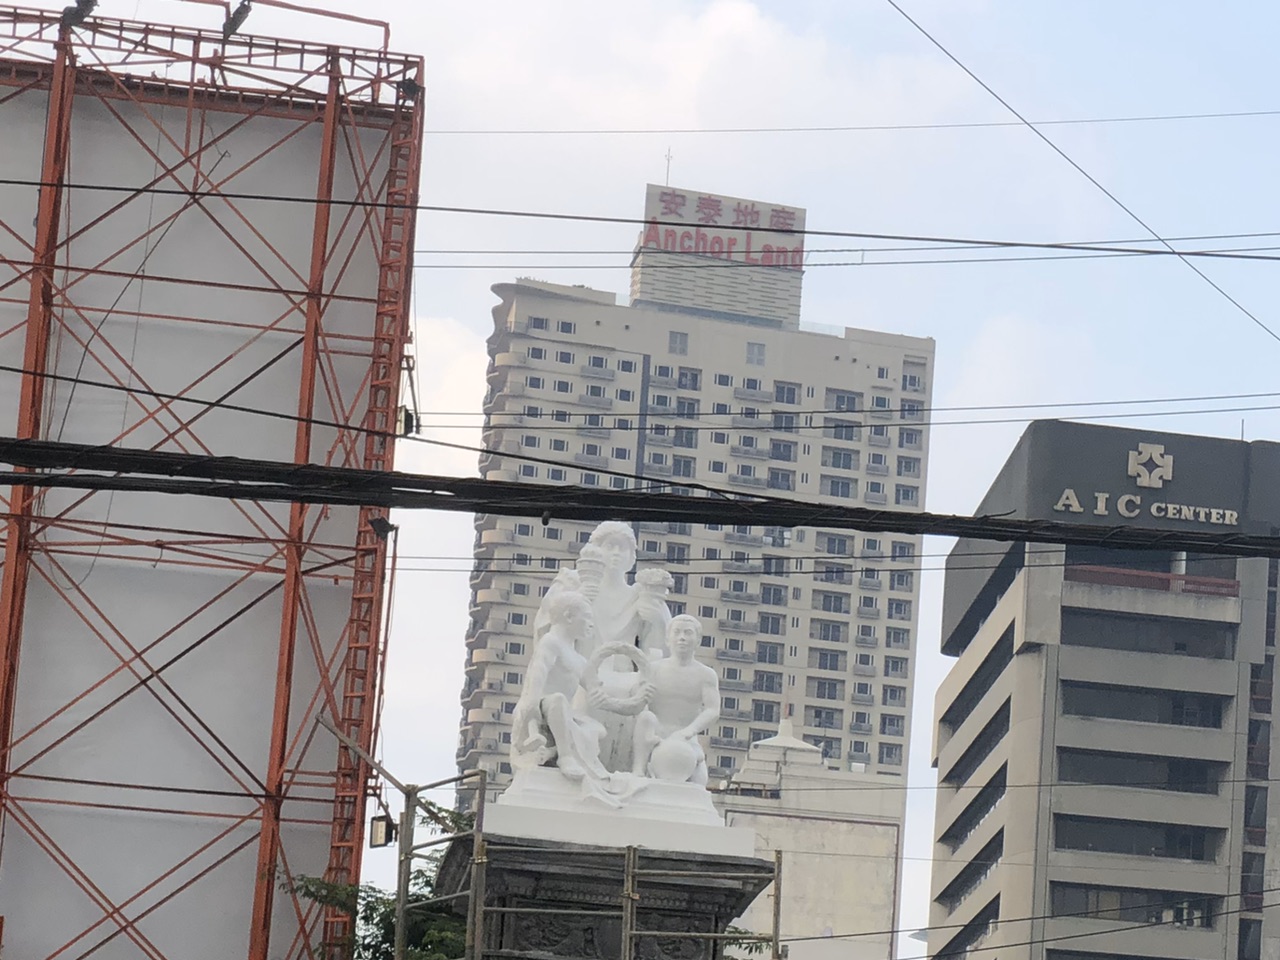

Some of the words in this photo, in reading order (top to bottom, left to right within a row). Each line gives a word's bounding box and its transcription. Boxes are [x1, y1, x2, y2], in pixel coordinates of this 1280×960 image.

[643, 216, 737, 261] Anchor
[745, 231, 805, 271] Land
[1149, 501, 1240, 526] CENTER
